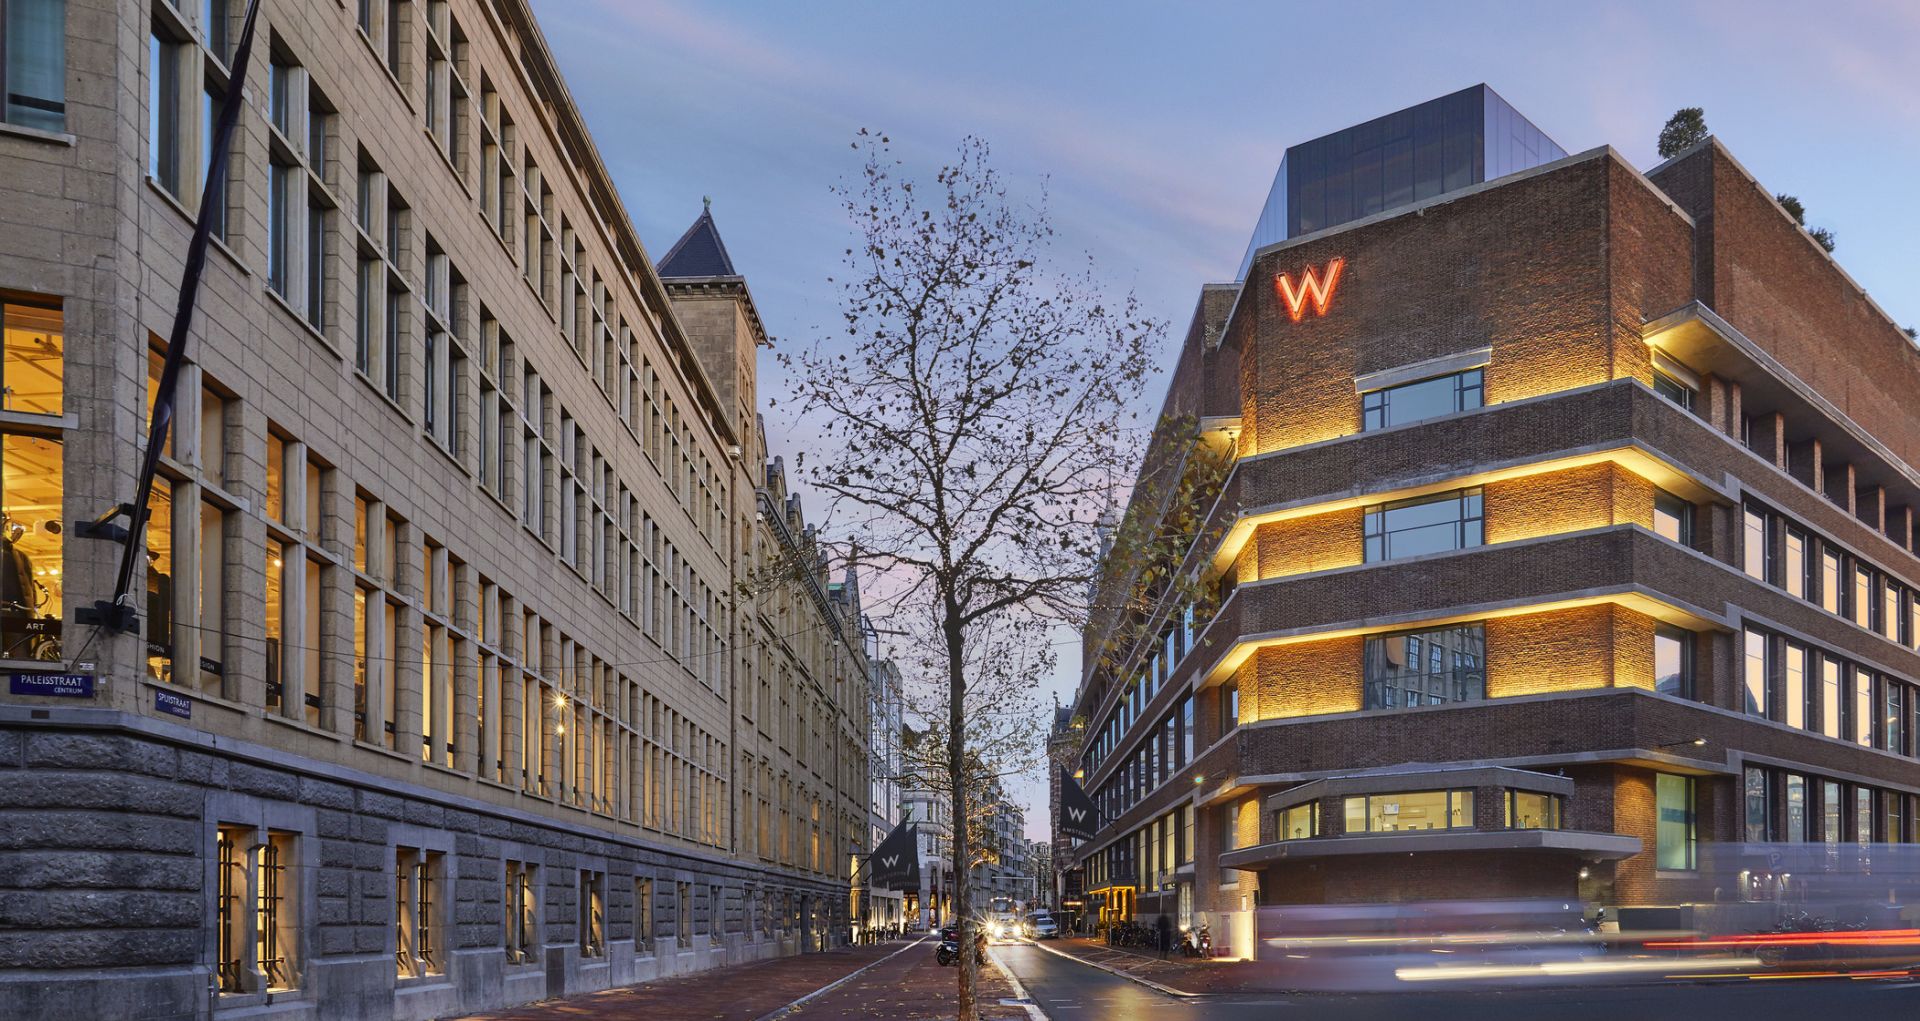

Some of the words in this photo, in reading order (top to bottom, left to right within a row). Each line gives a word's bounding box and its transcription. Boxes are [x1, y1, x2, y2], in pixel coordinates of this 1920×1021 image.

[1275, 257, 1344, 320] W
[21, 675, 82, 686] PALEISSTRAAT
[158, 692, 190, 708] SPUISTRAAT
[1068, 806, 1087, 823] W
[882, 854, 899, 868] W
